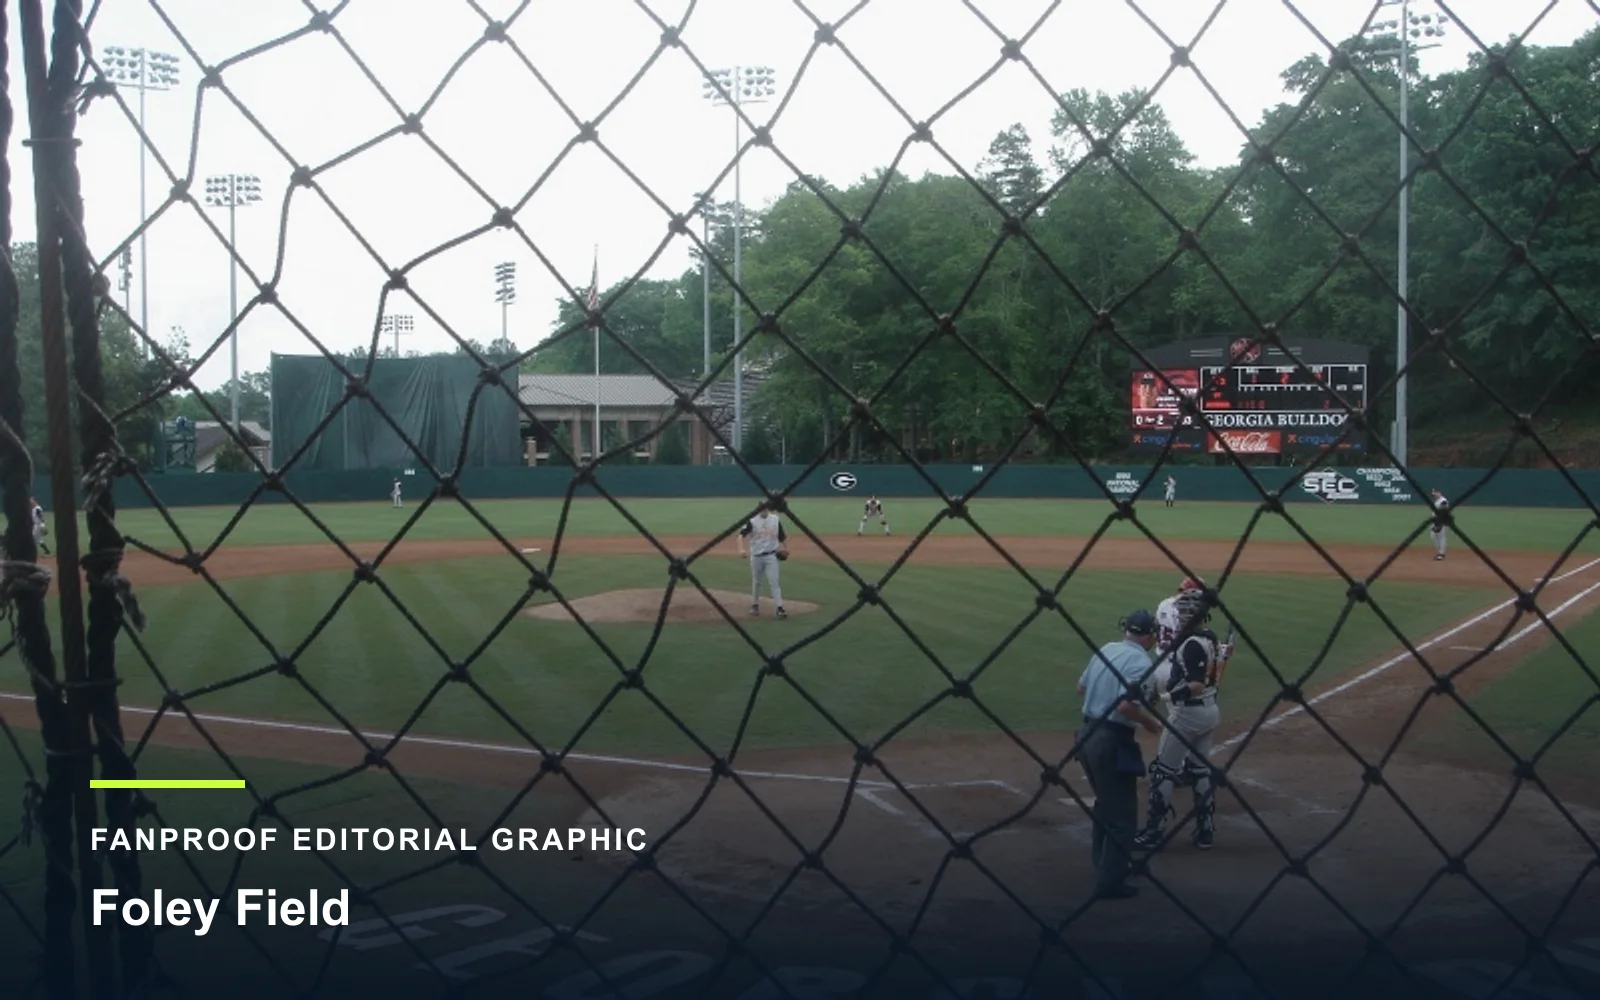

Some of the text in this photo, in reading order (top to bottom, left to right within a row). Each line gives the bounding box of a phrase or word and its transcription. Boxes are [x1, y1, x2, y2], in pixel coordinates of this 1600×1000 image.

[1204, 414, 1274, 427] GEORGIA
[1278, 414, 1349, 427] BULLDO
[833, 474, 856, 489] G
[1303, 478, 1356, 493] SEC
